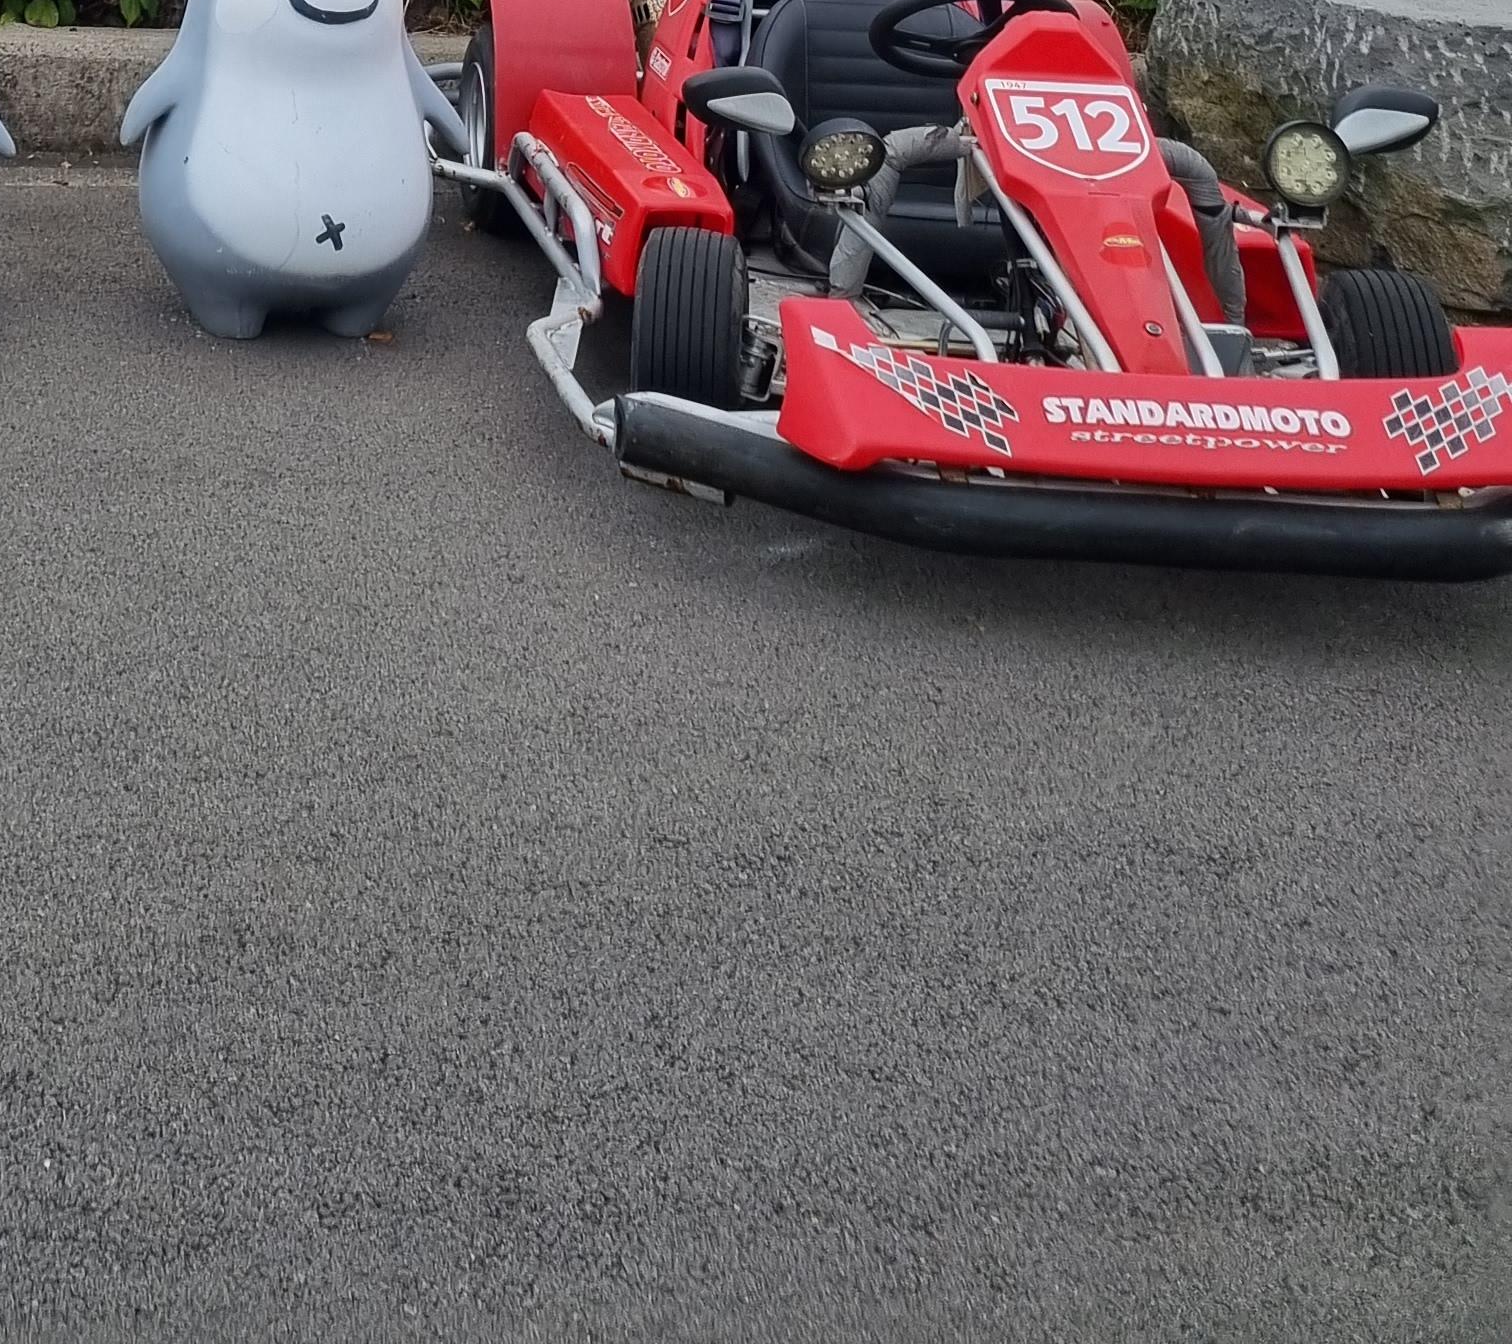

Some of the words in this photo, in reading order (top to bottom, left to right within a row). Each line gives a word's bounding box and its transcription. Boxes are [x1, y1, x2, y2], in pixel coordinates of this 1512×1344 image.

[1000, 80, 1027, 90] 1947
[1009, 95, 1142, 154] 512
[1042, 396, 1353, 438] STANDARDMOTO
[1070, 429, 1348, 454] streetpower
